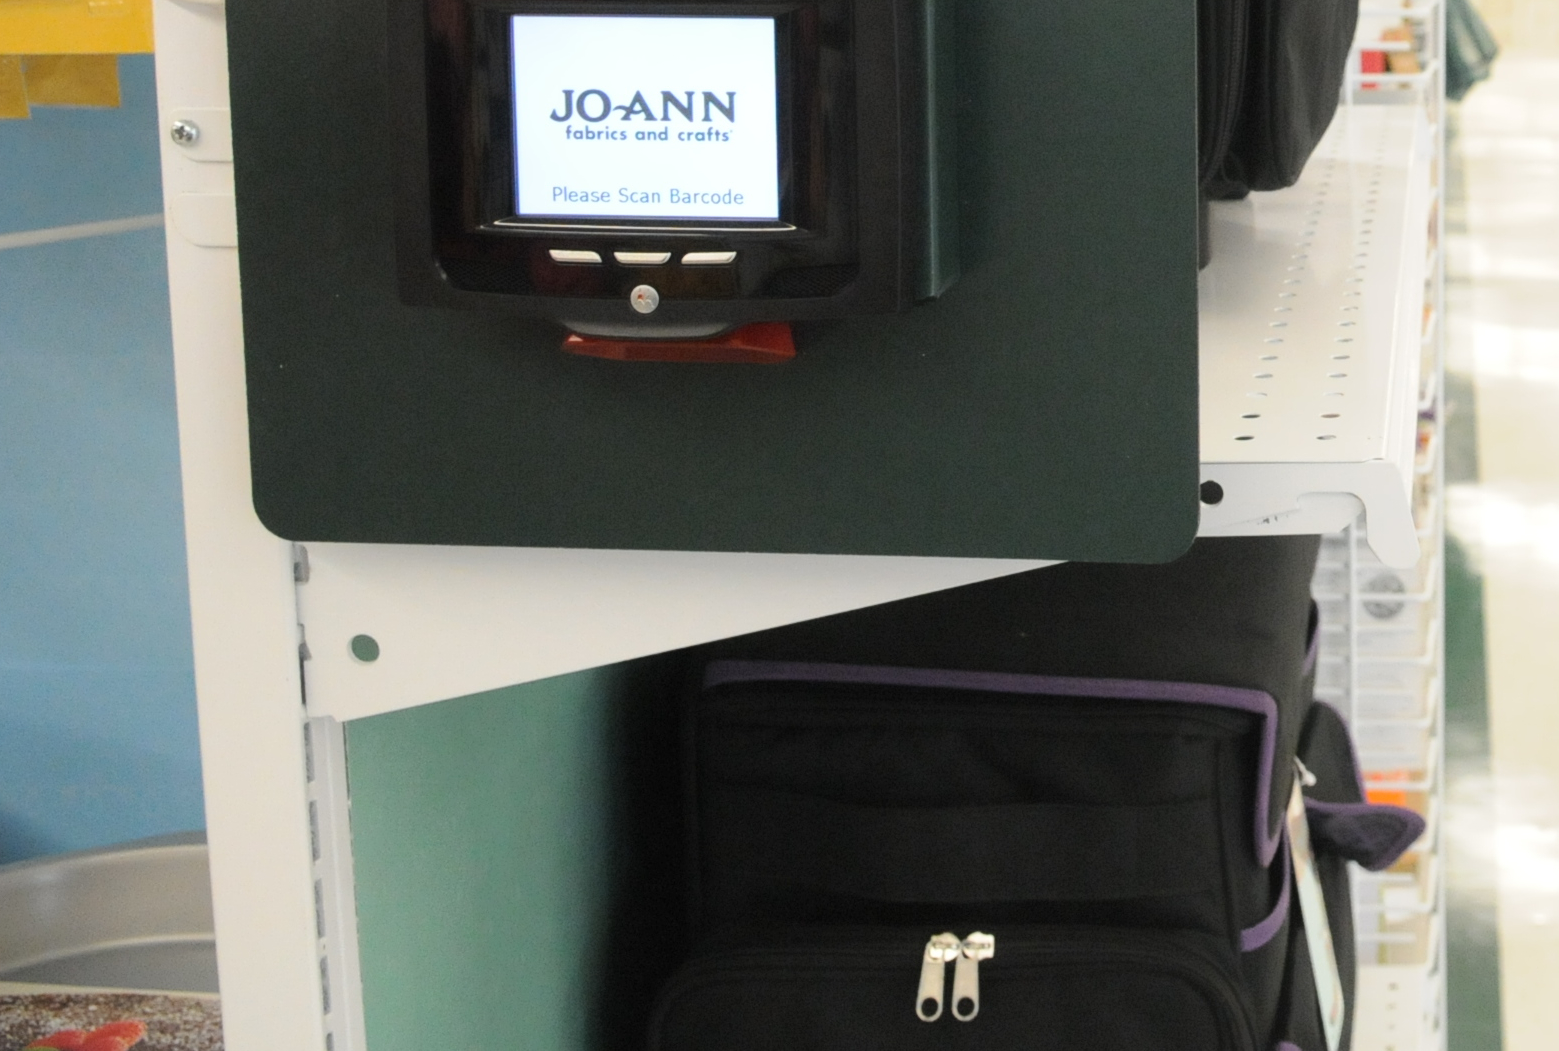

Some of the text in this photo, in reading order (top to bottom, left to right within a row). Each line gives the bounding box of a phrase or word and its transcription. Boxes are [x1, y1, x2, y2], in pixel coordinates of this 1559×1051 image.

[565, 125, 730, 142] fabrics and crafts
[552, 186, 744, 205] Please Scan Barcode
